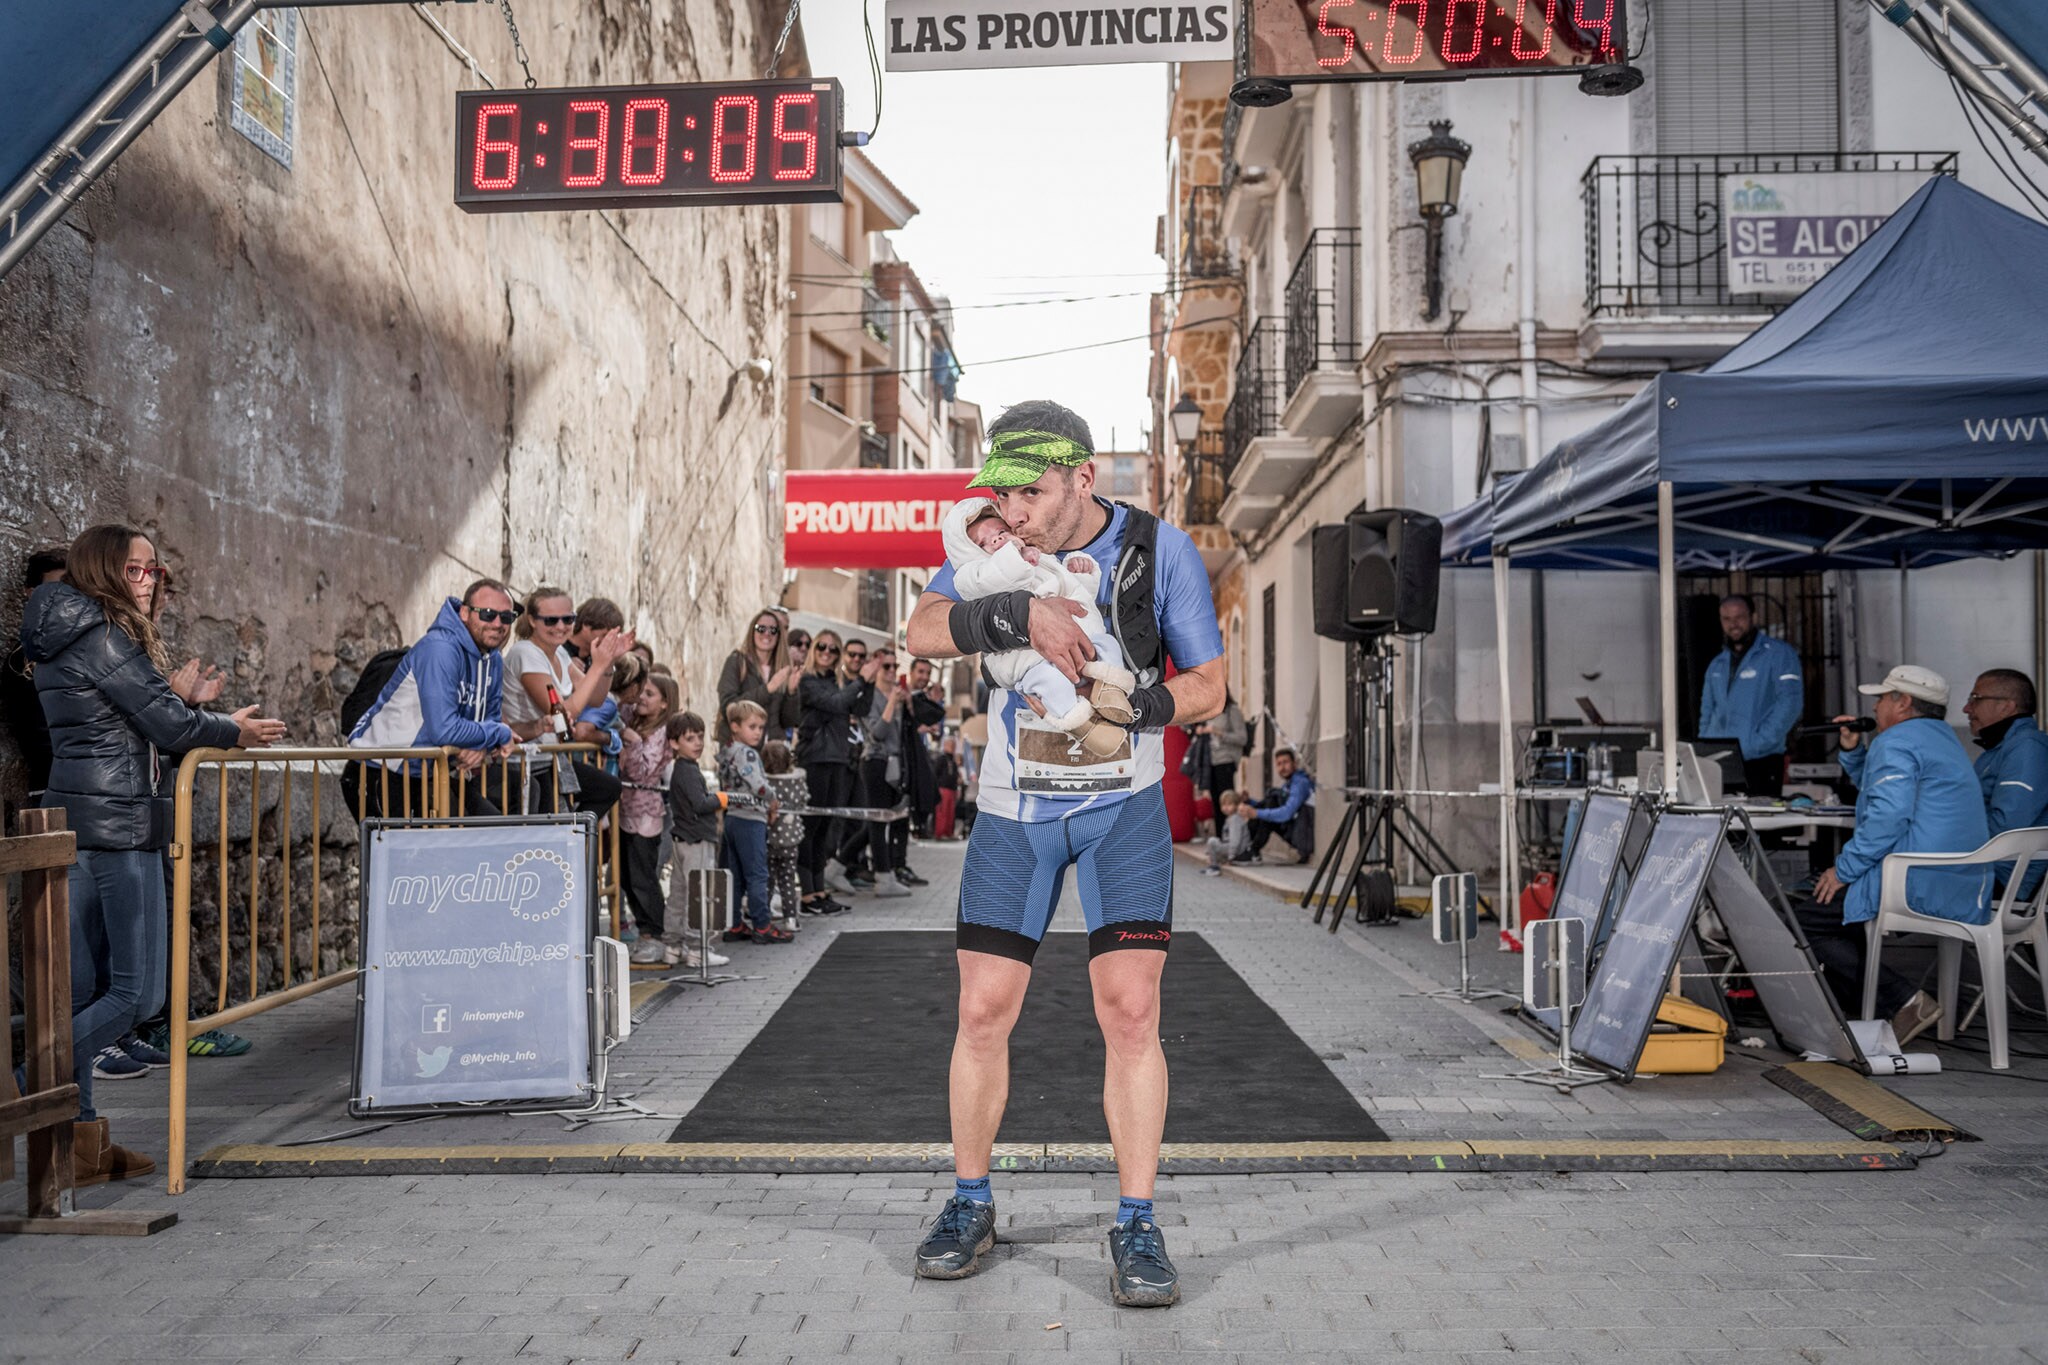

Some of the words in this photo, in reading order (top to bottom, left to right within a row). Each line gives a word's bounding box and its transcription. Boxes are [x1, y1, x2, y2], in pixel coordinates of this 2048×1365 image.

[890, 15, 967, 54] LAS
[977, 5, 1229, 50] PROVINCIAS
[473, 92, 819, 190] 6:30:05
[1736, 219, 1778, 255] SE
[388, 862, 541, 913] mychip
[384, 942, 569, 968] www.mychip.es
[462, 1009, 525, 1022] /infomychip
